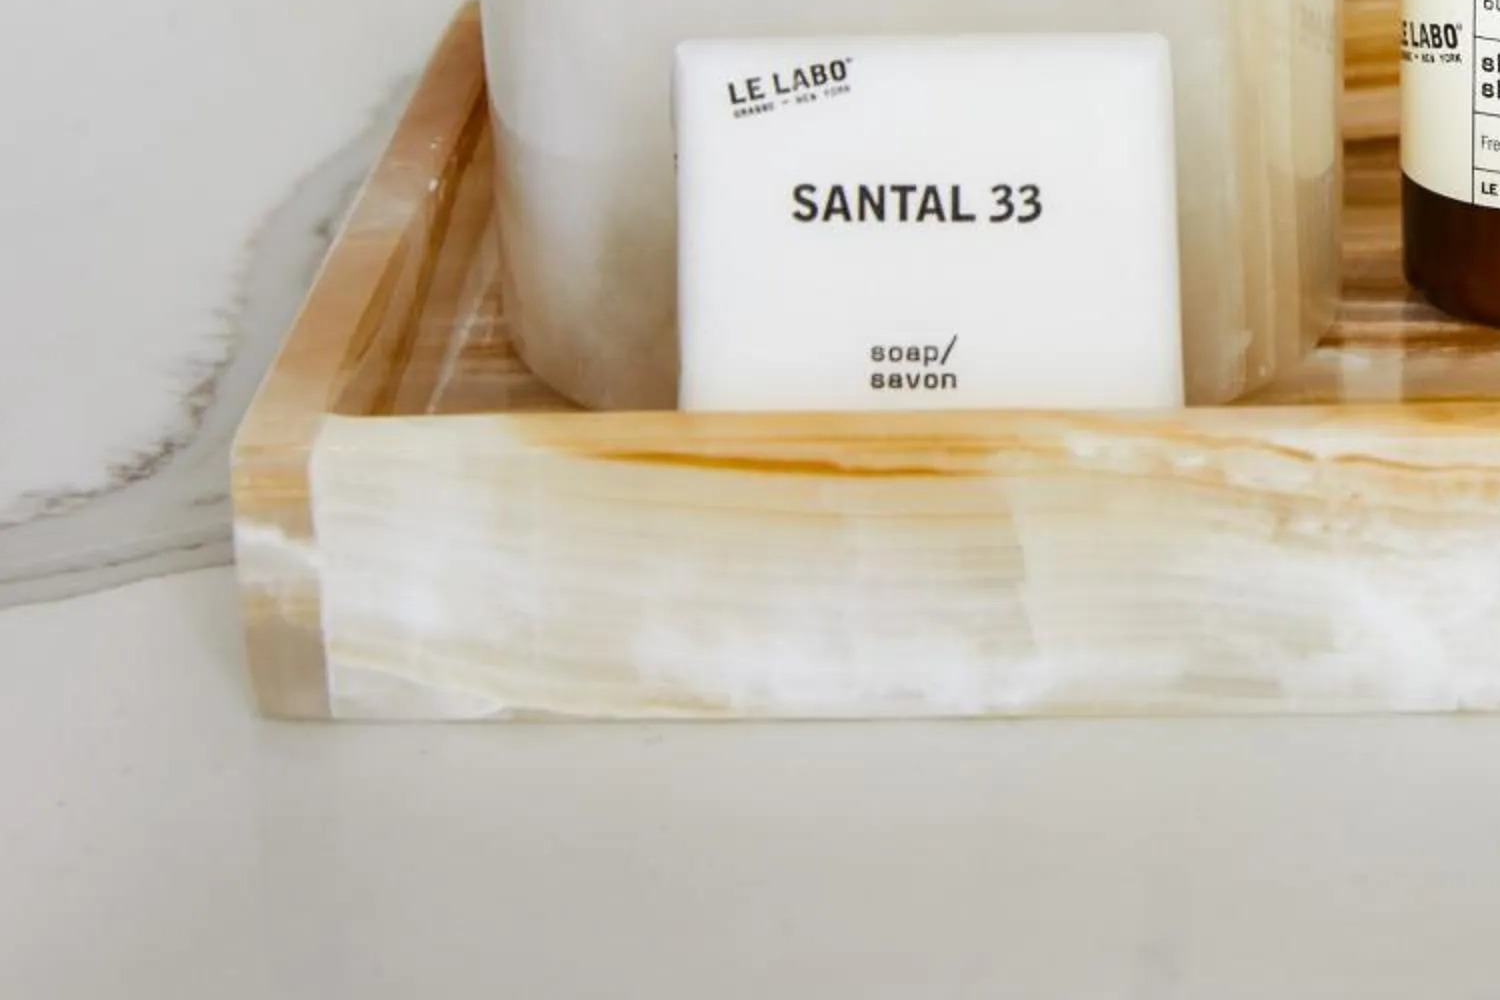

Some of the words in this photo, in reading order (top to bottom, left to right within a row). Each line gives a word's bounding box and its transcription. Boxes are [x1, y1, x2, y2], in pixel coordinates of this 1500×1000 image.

[728, 77, 766, 104] LE
[1481, 181, 1499, 196] LE
[791, 183, 977, 224] SANTAL
[989, 183, 1043, 224] 33
[870, 334, 959, 366] soap/
[870, 372, 958, 391] savon
